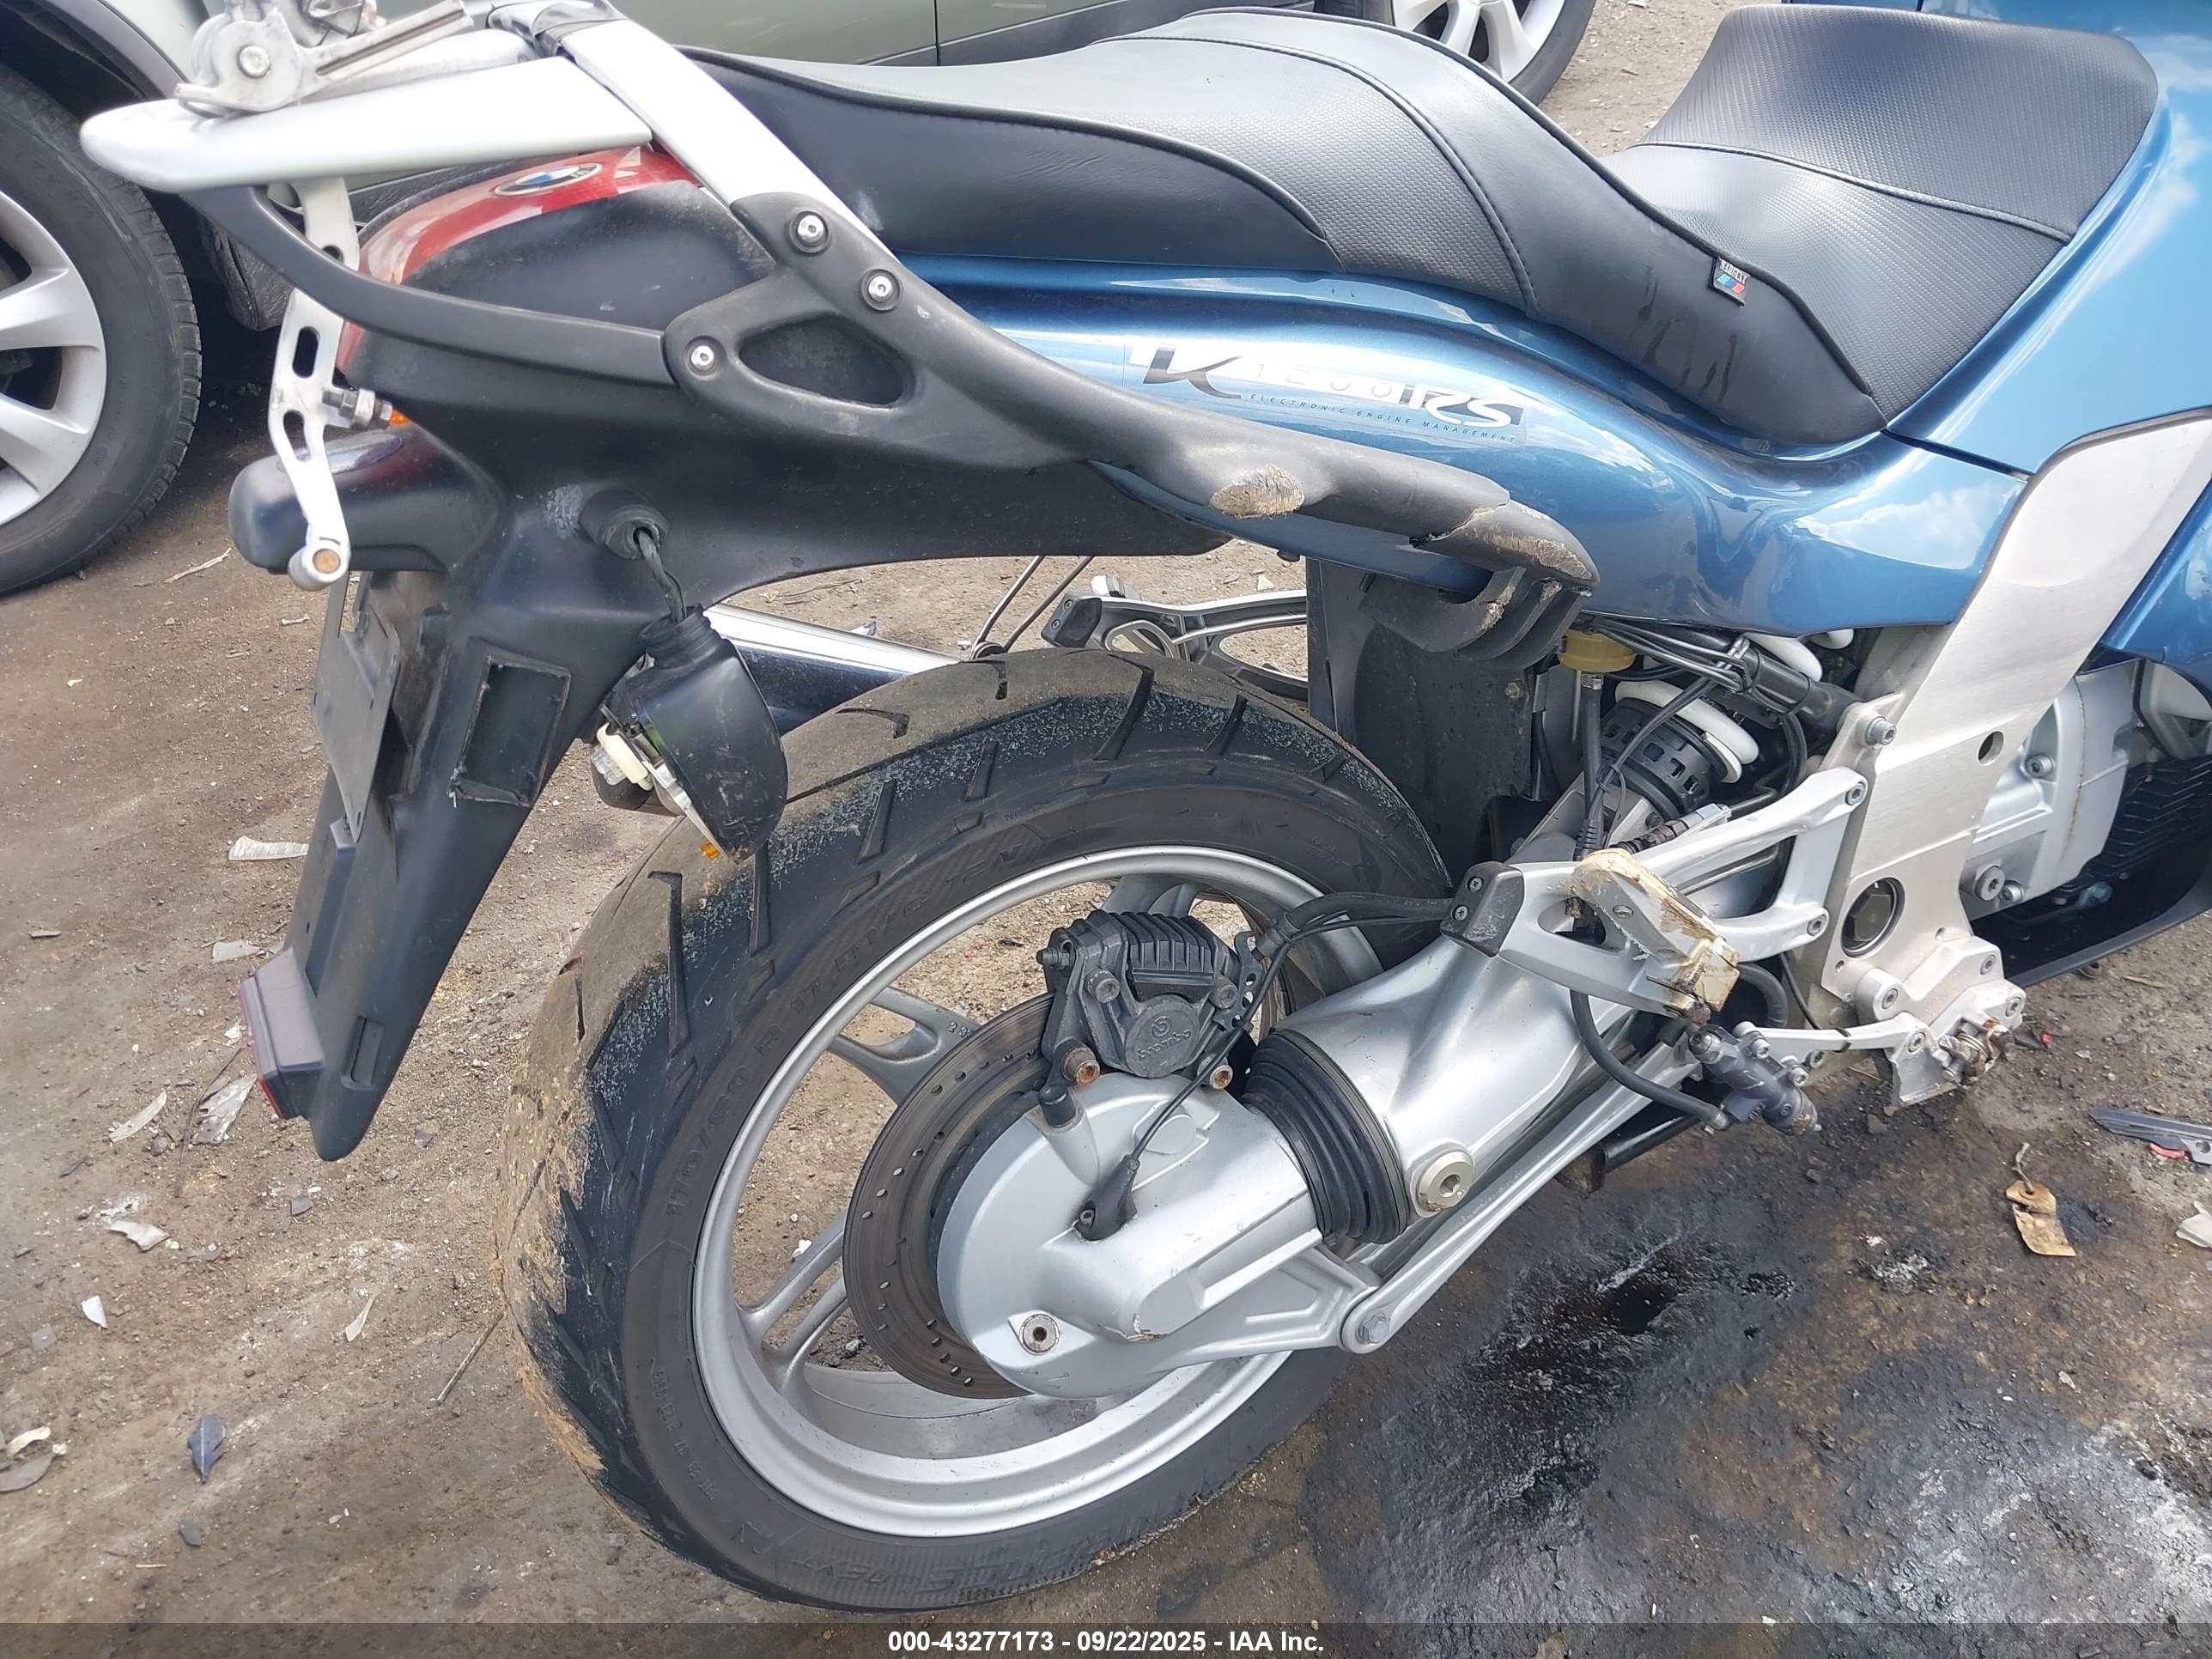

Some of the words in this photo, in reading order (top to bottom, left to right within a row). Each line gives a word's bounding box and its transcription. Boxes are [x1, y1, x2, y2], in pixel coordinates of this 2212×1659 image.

[1250, 392, 1346, 414] ELECTRONIC
[1355, 410, 1412, 424] ENGINE
[1422, 420, 1516, 443] MANAGEMENT
[1136, 1029, 1192, 1061] brembo
